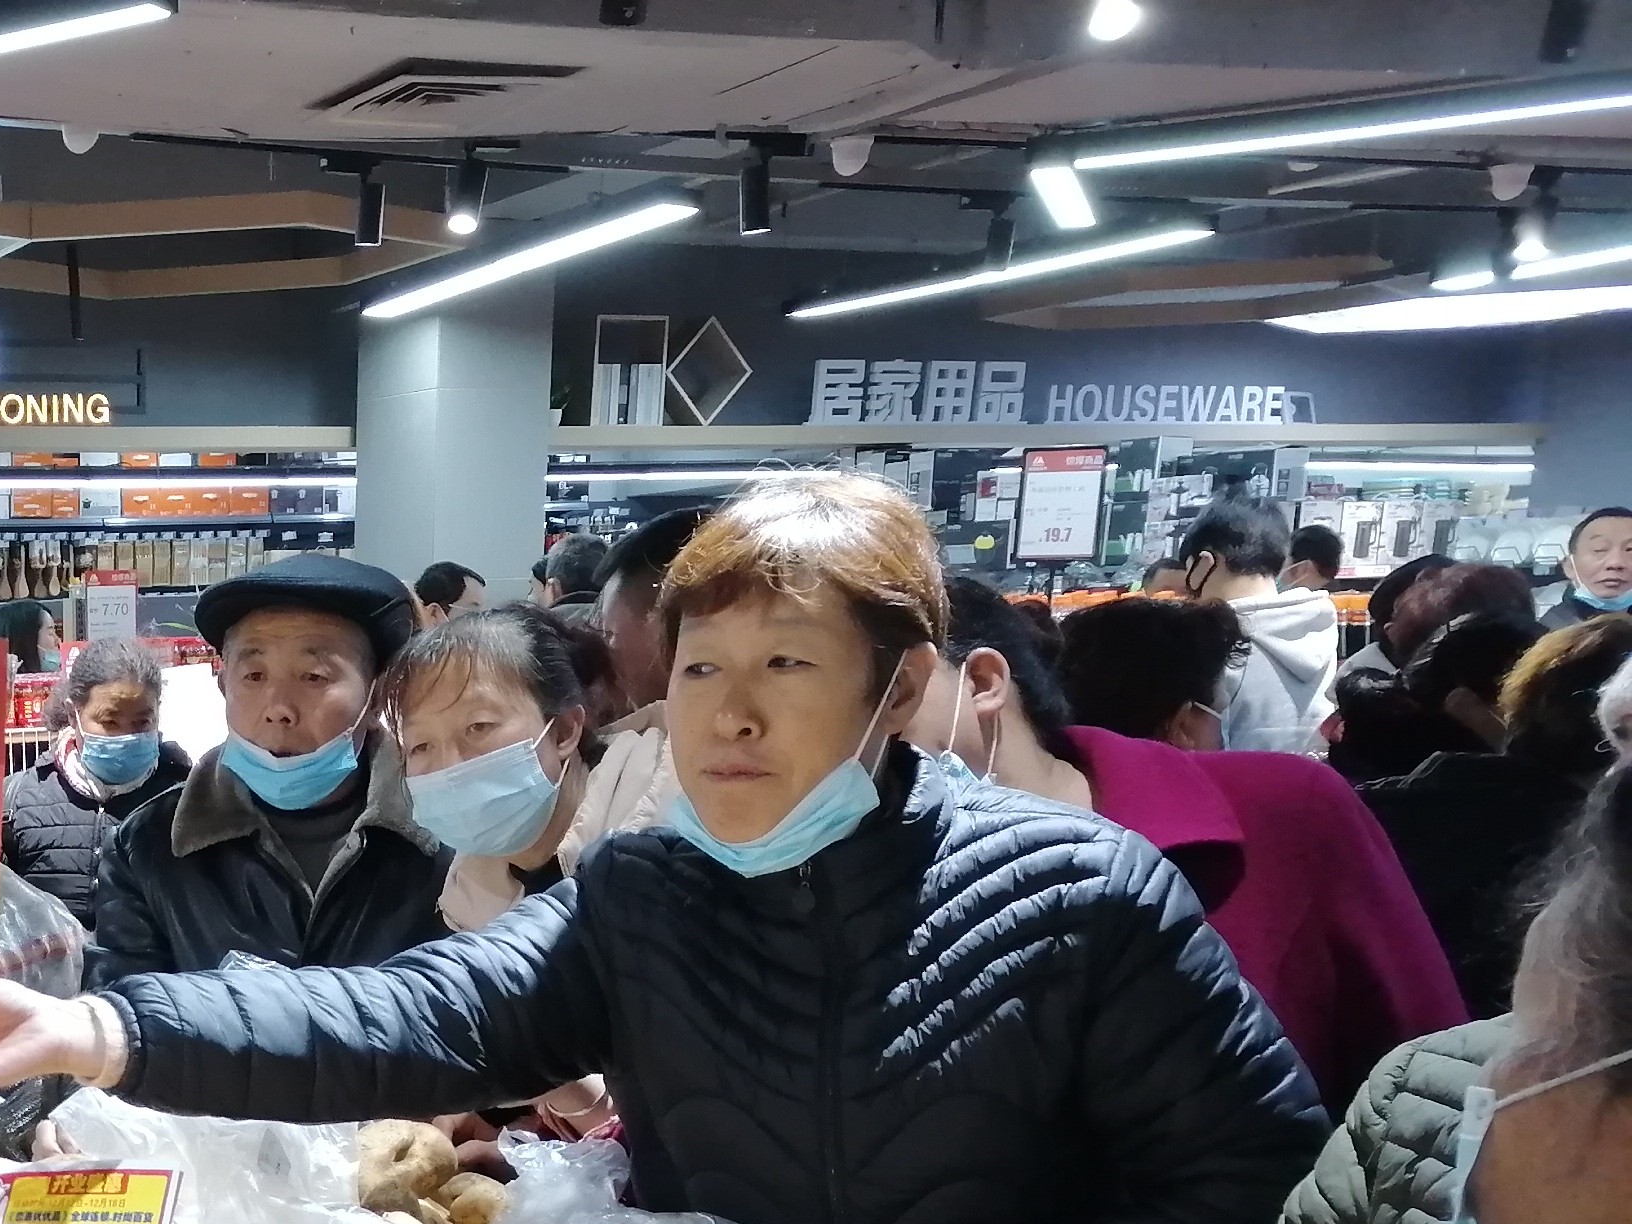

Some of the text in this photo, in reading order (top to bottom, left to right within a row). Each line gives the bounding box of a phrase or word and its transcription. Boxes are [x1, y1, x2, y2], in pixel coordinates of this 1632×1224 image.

[811, 358, 1027, 423] 居家用品
[1049, 384, 1286, 424] HOUSEWARE
[102, 603, 129, 616] 7.70
